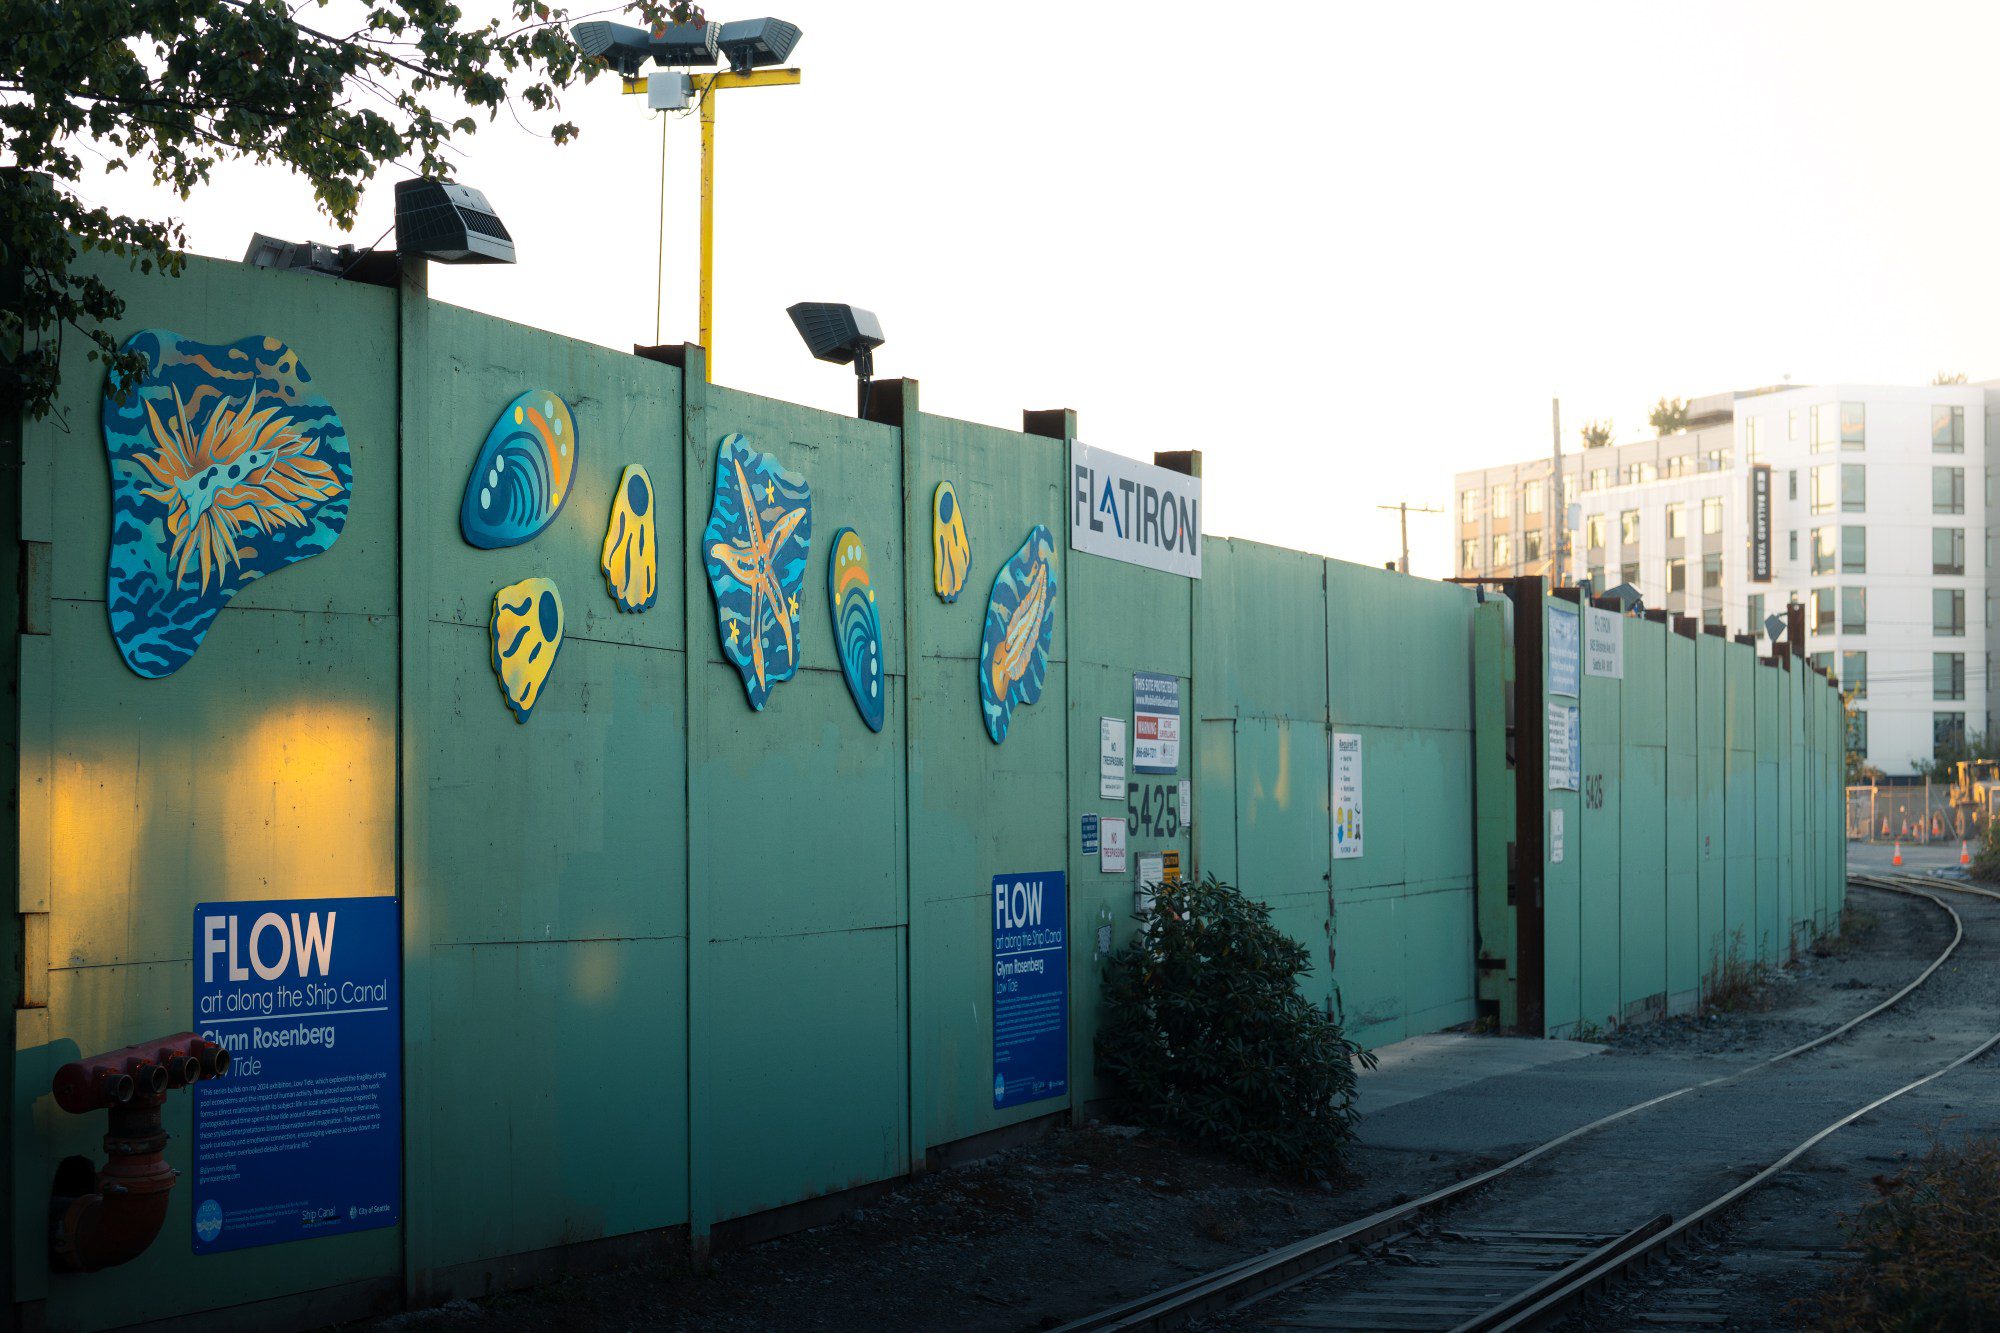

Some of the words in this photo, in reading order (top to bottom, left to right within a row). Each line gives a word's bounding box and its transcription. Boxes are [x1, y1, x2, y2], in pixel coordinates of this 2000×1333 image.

[1075, 464, 1197, 556] FLATIRON
[1135, 678, 1145, 690] THIS
[1145, 679, 1154, 691] SITE
[1154, 680, 1172, 693] PROTECTED
[1173, 682, 1178, 694] BY
[1137, 721, 1157, 735] WARNING
[1111, 742, 1117, 751] NO
[1103, 755, 1124, 767] TRESPASSING
[1586, 774, 1603, 809] 5425
[1127, 782, 1177, 838] 5425
[1111, 832, 1117, 844] NO
[1103, 847, 1125, 858] TRESPASSING
[996, 881, 1043, 930] FLOW
[205, 911, 337, 982] FLOW
[996, 934, 1004, 950] art
[1006, 931, 1021, 950] along
[1022, 931, 1031, 946] the
[1032, 930, 1044, 948] Ship
[1045, 927, 1062, 944] Canal
[996, 960, 1013, 979] Glynn
[1014, 957, 1044, 974] Rosenberg
[201, 990, 223, 1013] art
[226, 988, 273, 1015] along
[276, 985, 303, 1008] the
[306, 982, 337, 1009] Ship
[341, 979, 387, 1004] Canal
[997, 981, 1007, 994] Low
[1008, 979, 1018, 992] Tide
[253, 1024, 335, 1049] Rosenberg
[233, 1056, 262, 1078] Tide
[270, 1081, 292, 1089] exhibition,
[329, 1075, 348, 1084] explored
[357, 1073, 373, 1081] fragility
[201, 1099, 211, 1108] pool
[212, 1097, 238, 1106] ecosystems
[238, 1095, 247, 1103] and
[257, 1093, 272, 1102] impact
[324, 1086, 339, 1095] placed
[218, 1108, 232, 1116] direct
[233, 1105, 260, 1114] relationship
[320, 1096, 340, 1105] intertidal
[354, 1093, 371, 1102] Inspired
[200, 1118, 230, 1129] photographs
[251, 1114, 264, 1123] spent
[289, 1110, 305, 1118] around
[306, 1108, 322, 1116] Seattle
[322, 1107, 330, 1115] and
[339, 1105, 357, 1114] Olympic
[232, 1126, 266, 1135] interpretations
[266, 1123, 279, 1131] blend
[280, 1121, 306, 1130] observation
[306, 1119, 316, 1127] and
[353, 1114, 366, 1123] pieces
[200, 1142, 212, 1151] spark
[246, 1135, 270, 1144] emotional
[297, 1129, 325, 1138] encouraging
[238, 1147, 264, 1156] overlooked
[264, 1145, 279, 1153] details
[284, 1143, 301, 1151] marine
[302, 1210, 316, 1223] Ship
[317, 1205, 336, 1218] Canal
[359, 1207, 368, 1216] City
[374, 1204, 391, 1213] Seattle
